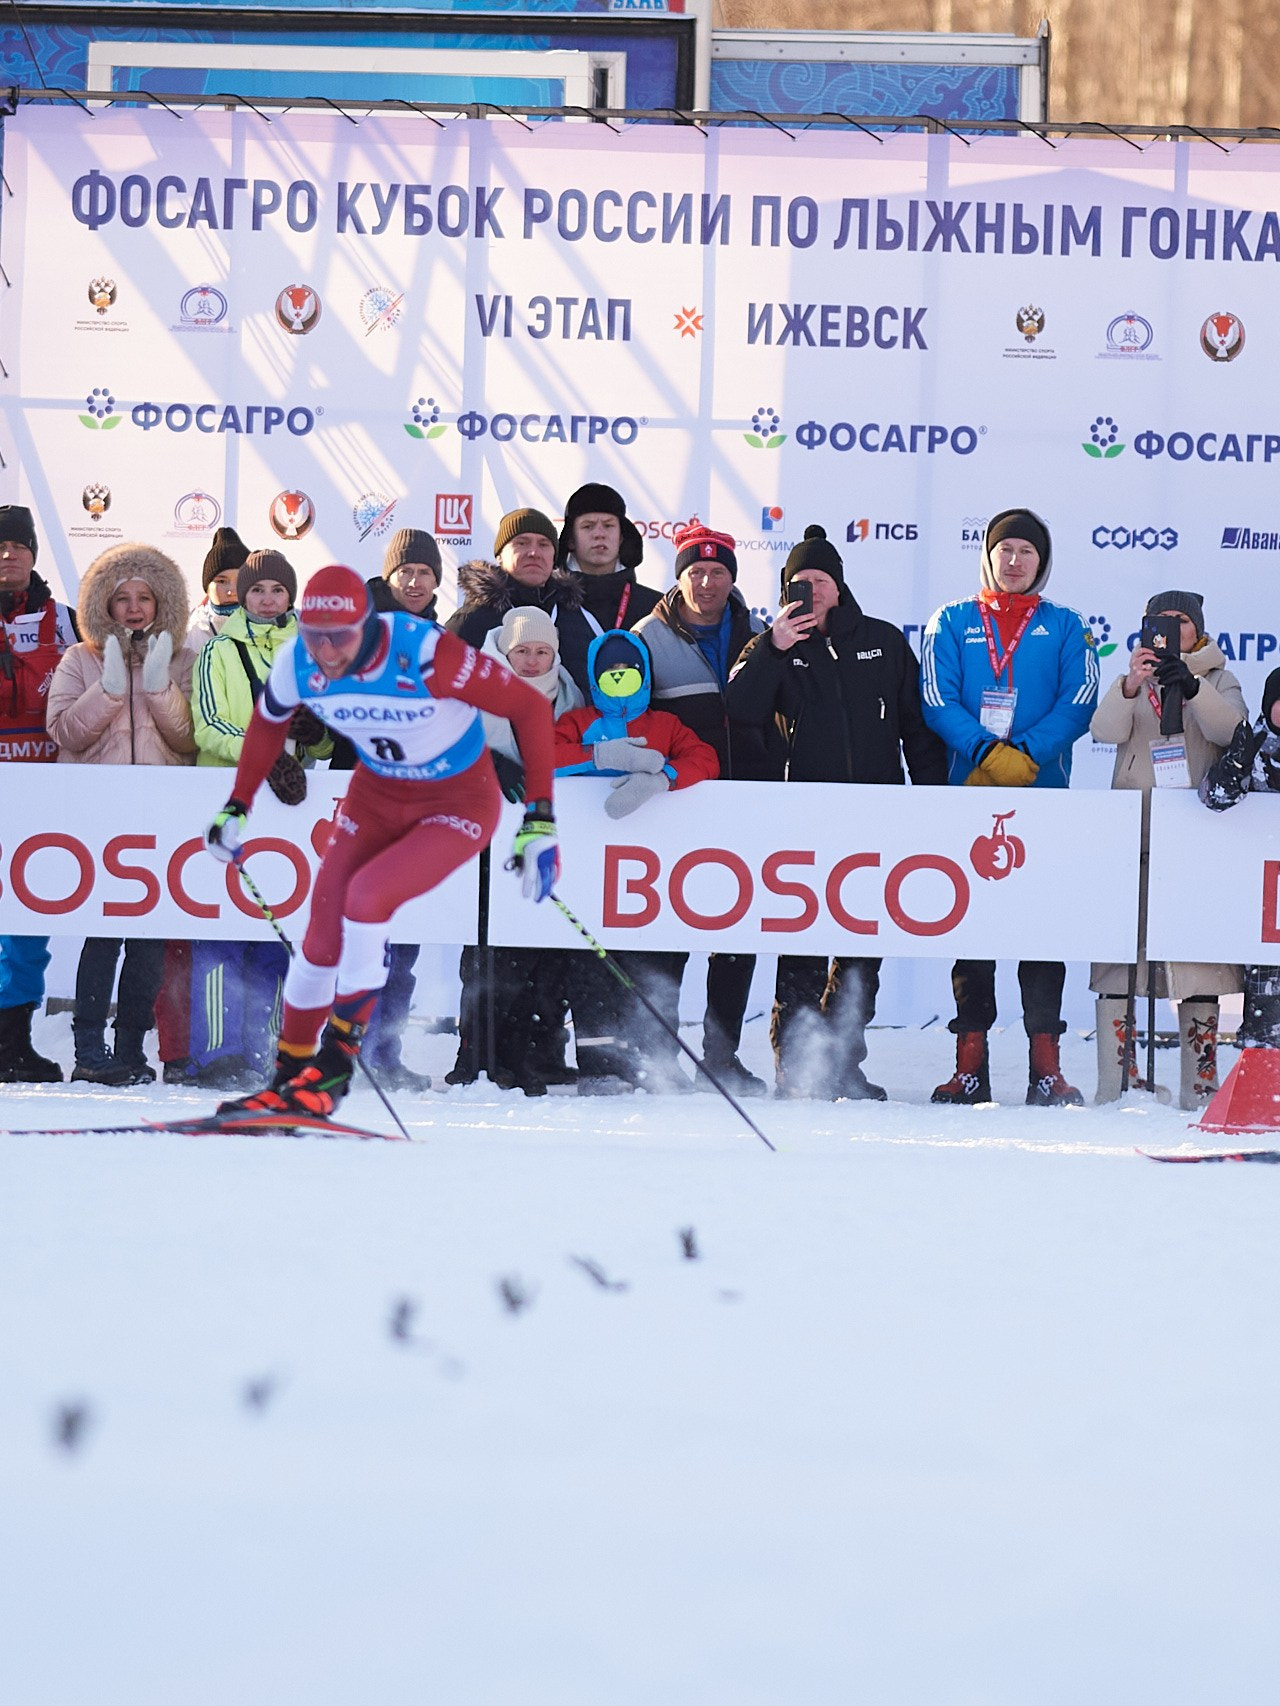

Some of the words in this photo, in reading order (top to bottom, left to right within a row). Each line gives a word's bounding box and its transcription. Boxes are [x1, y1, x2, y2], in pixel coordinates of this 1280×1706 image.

[72, 170, 318, 232] ФОСАГРО
[337, 182, 504, 239] КУБОК
[524, 188, 730, 245] РОССИИ
[752, 195, 818, 249] ПО
[834, 198, 1101, 257] ЛЫЖНЫМ
[475, 294, 512, 337] VI
[527, 295, 631, 341] ЭТАП
[748, 303, 928, 350] ИЖЕВСК
[632, 521, 691, 539] OSCO
[735, 540, 795, 552] РУСКЛИМ
[876, 524, 918, 540] ПСБ
[1092, 525, 1178, 551] СОЮЗ
[20, 633, 38, 643] ПС
[0, 832, 312, 920] OSCO
[603, 844, 970, 937] BOSCO
